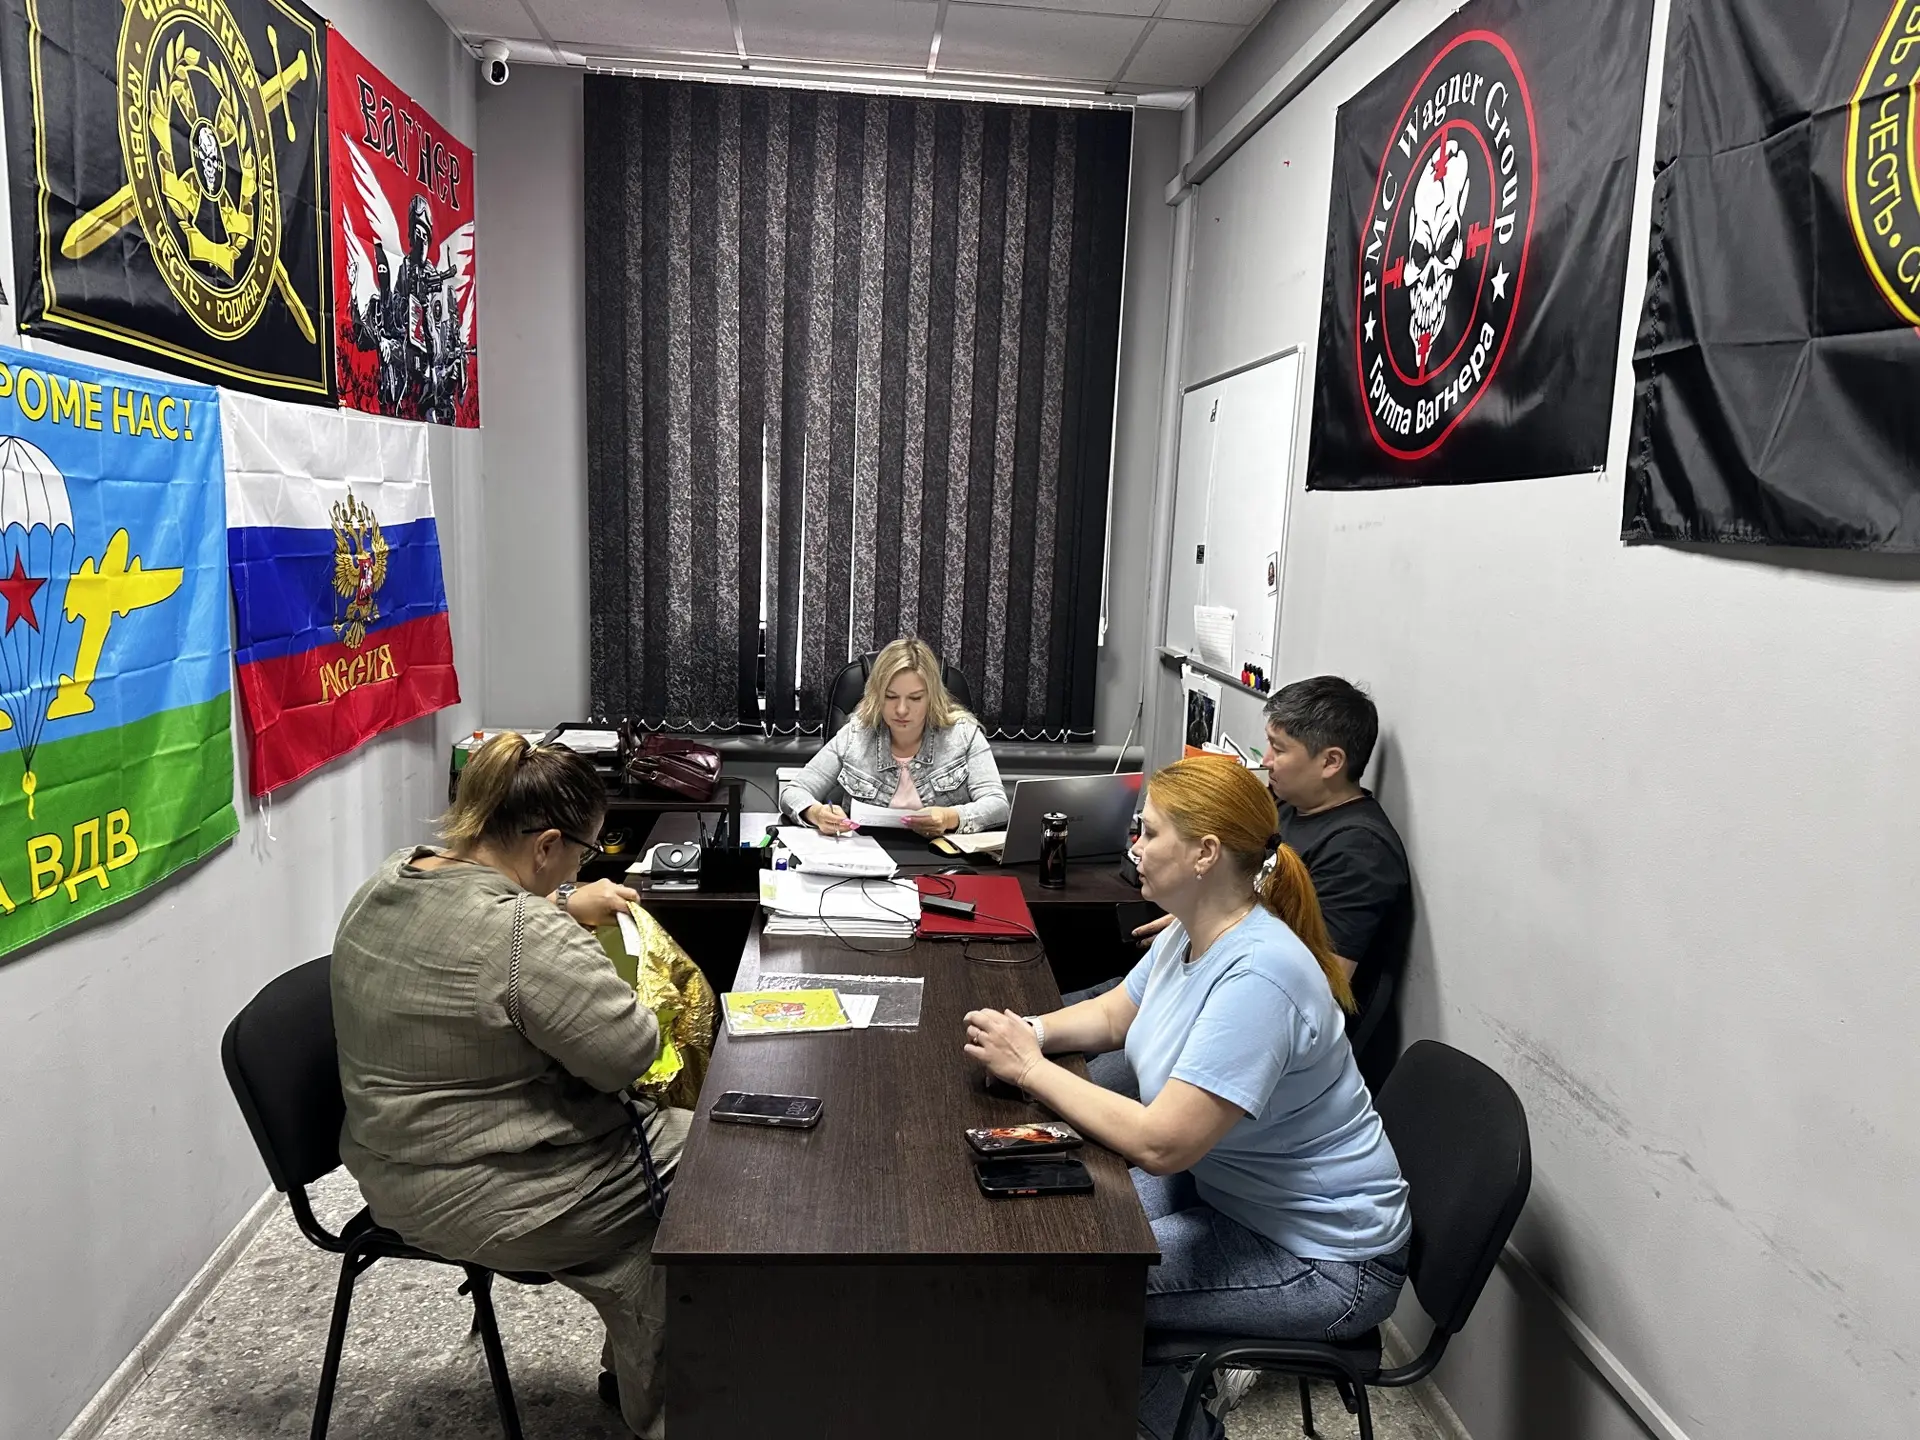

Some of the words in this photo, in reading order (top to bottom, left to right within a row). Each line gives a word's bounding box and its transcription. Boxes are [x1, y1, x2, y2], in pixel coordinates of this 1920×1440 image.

[128, 62, 147, 180] КРОВЬ
[155, 220, 200, 306] ЧЕСТЬ
[216, 278, 262, 327] РОДИНА
[260, 153, 273, 257] ОТВАГА
[1364, 170, 1397, 300] PMC
[1397, 71, 1484, 159] Wagner
[1485, 81, 1518, 245] Group
[1867, 93, 1902, 236] ЧЕСТЬ
[1369, 353, 1412, 435] Группа
[1416, 322, 1495, 434] Вагнера
[318, 643, 399, 704] РОССИЯ
[27, 806, 140, 904] ВДВ
